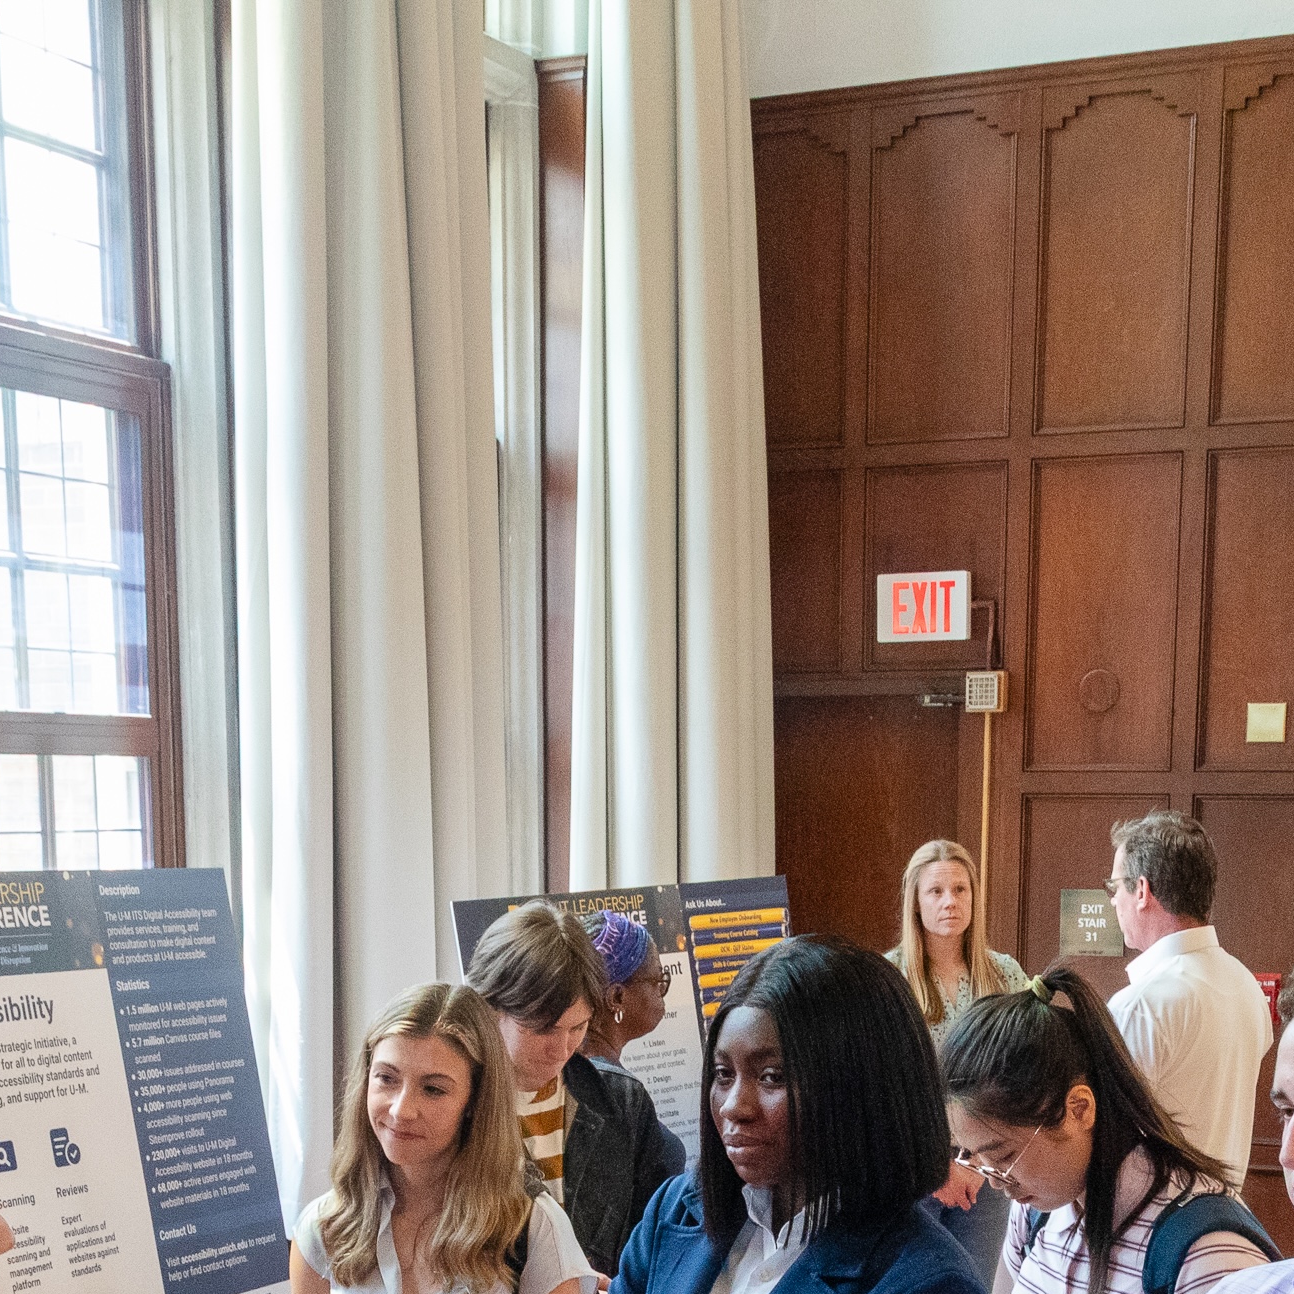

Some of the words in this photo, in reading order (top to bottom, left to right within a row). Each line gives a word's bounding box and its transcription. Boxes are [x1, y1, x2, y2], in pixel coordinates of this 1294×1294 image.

[893, 581, 956, 635] EXIT
[97, 883, 141, 898] Description
[573, 894, 644, 915] LEADERSHIP
[686, 900, 697, 909] Ask
[697, 899, 705, 908] Us
[1081, 904, 1104, 914] EXIT
[1078, 918, 1106, 928] STAIR
[1085, 931, 1097, 942] 31
[115, 978, 151, 992] Statistics
[32, 1034, 71, 1050] Initiative,
[71, 1036, 78, 1046] a
[0, 1057, 14, 1071] for
[14, 1055, 26, 1069] all
[25, 1056, 36, 1068] to
[36, 1051, 62, 1069] digital
[62, 1049, 93, 1063] content
[44, 1066, 85, 1082] standards
[85, 1063, 101, 1077] and
[653, 1075, 672, 1084] Design
[5, 1090, 23, 1105] and
[22, 1087, 56, 1104] support
[55, 1085, 68, 1097] for
[68, 1081, 89, 1096] U-M.
[54, 1183, 89, 1199] Reviews
[158, 1225, 188, 1241] Contact
[185, 1223, 197, 1235] Us
